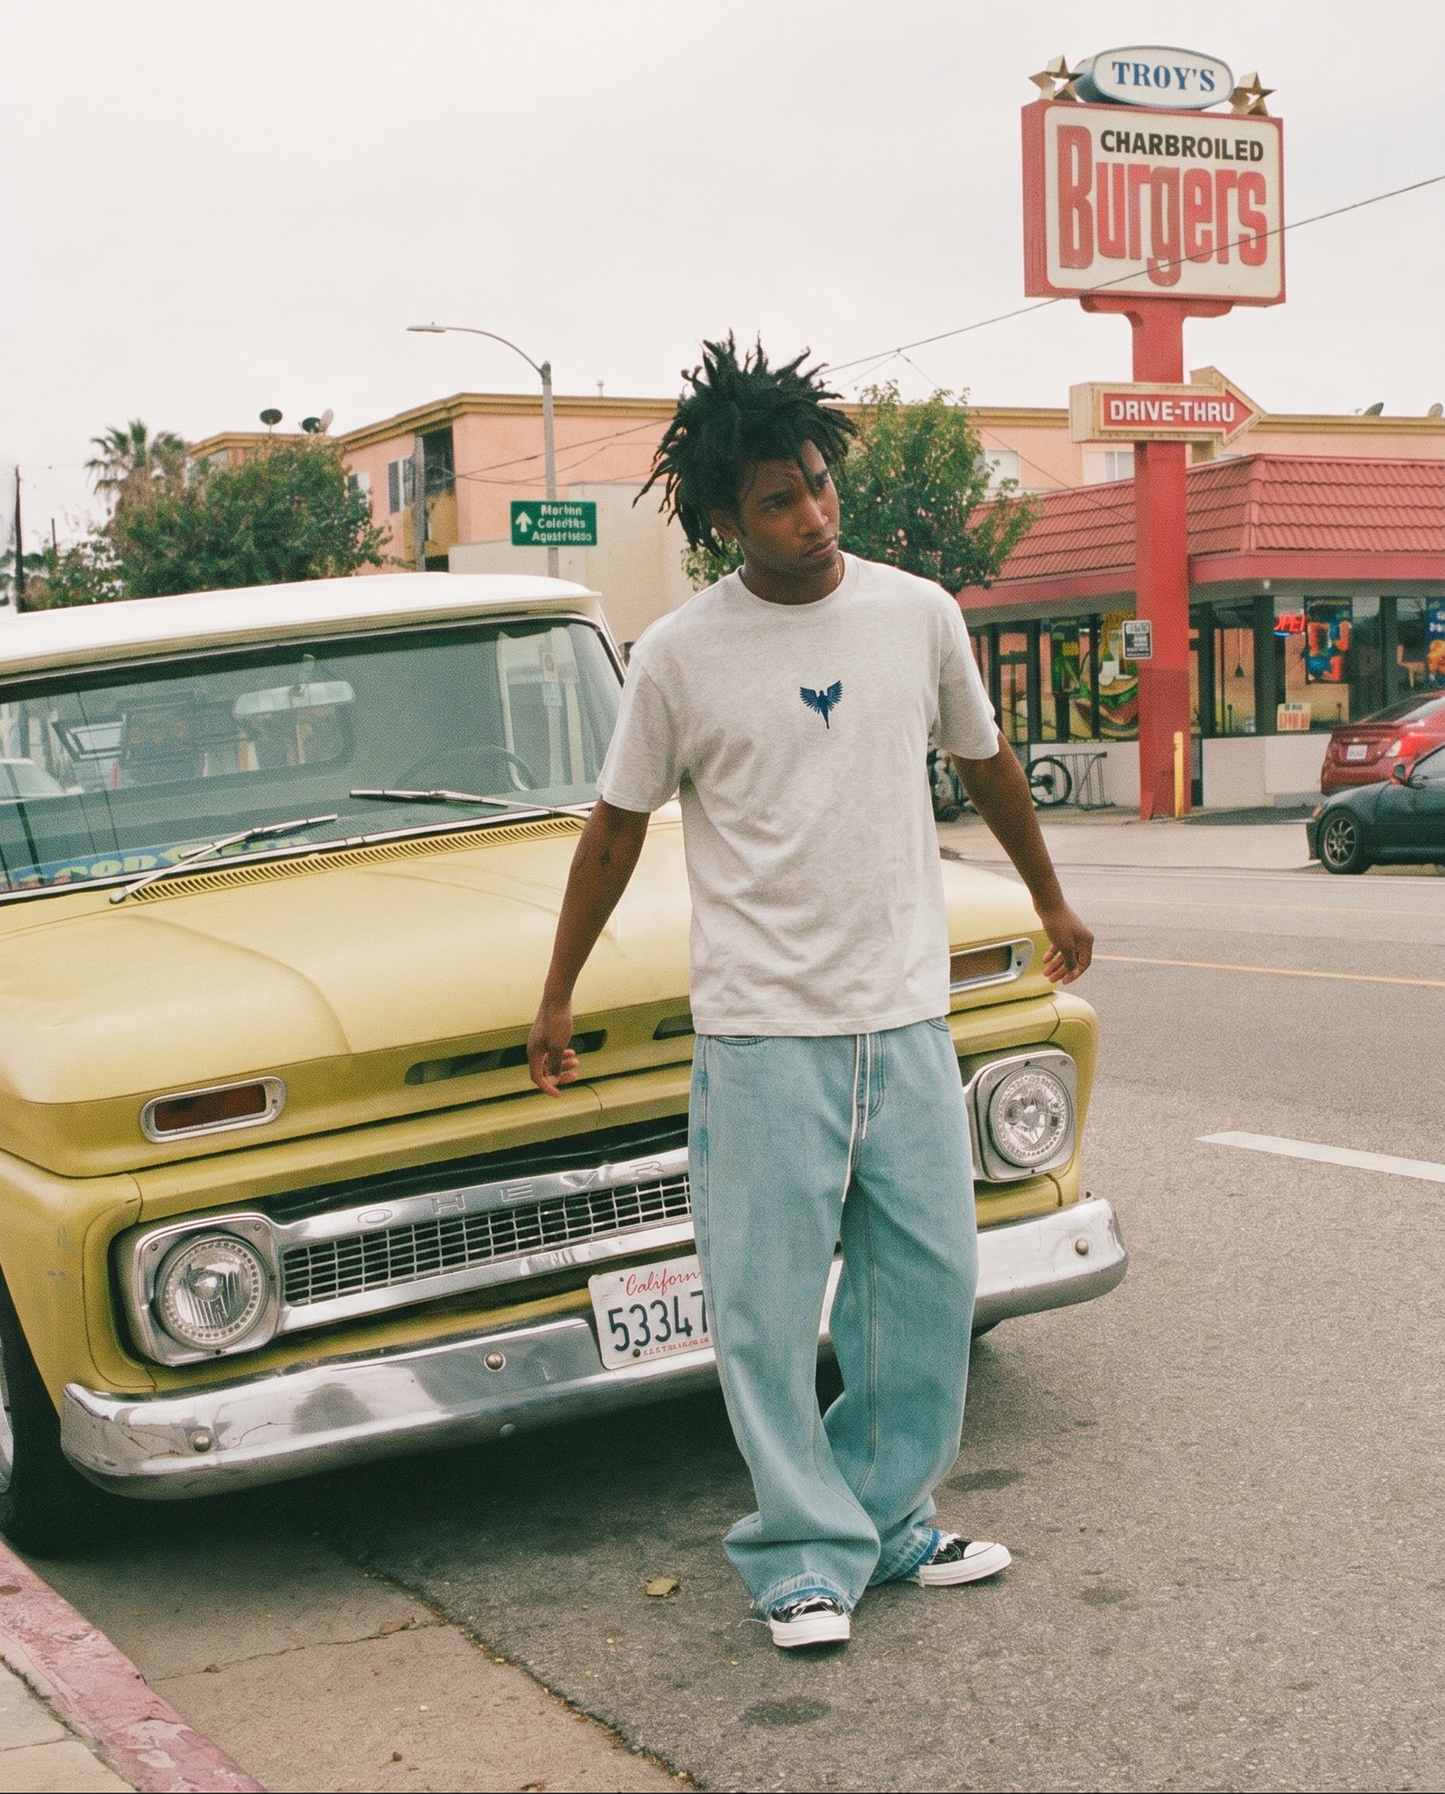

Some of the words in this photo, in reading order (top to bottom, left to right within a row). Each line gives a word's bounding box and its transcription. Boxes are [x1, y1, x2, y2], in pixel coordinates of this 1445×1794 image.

[1112, 61, 1215, 92] TROY'S
[1100, 130, 1264, 162] CHARBROILED
[1057, 125, 1268, 287] Burgers
[1110, 400, 1235, 422] DRIVE-THRU
[608, 1289, 708, 1352] 53347
